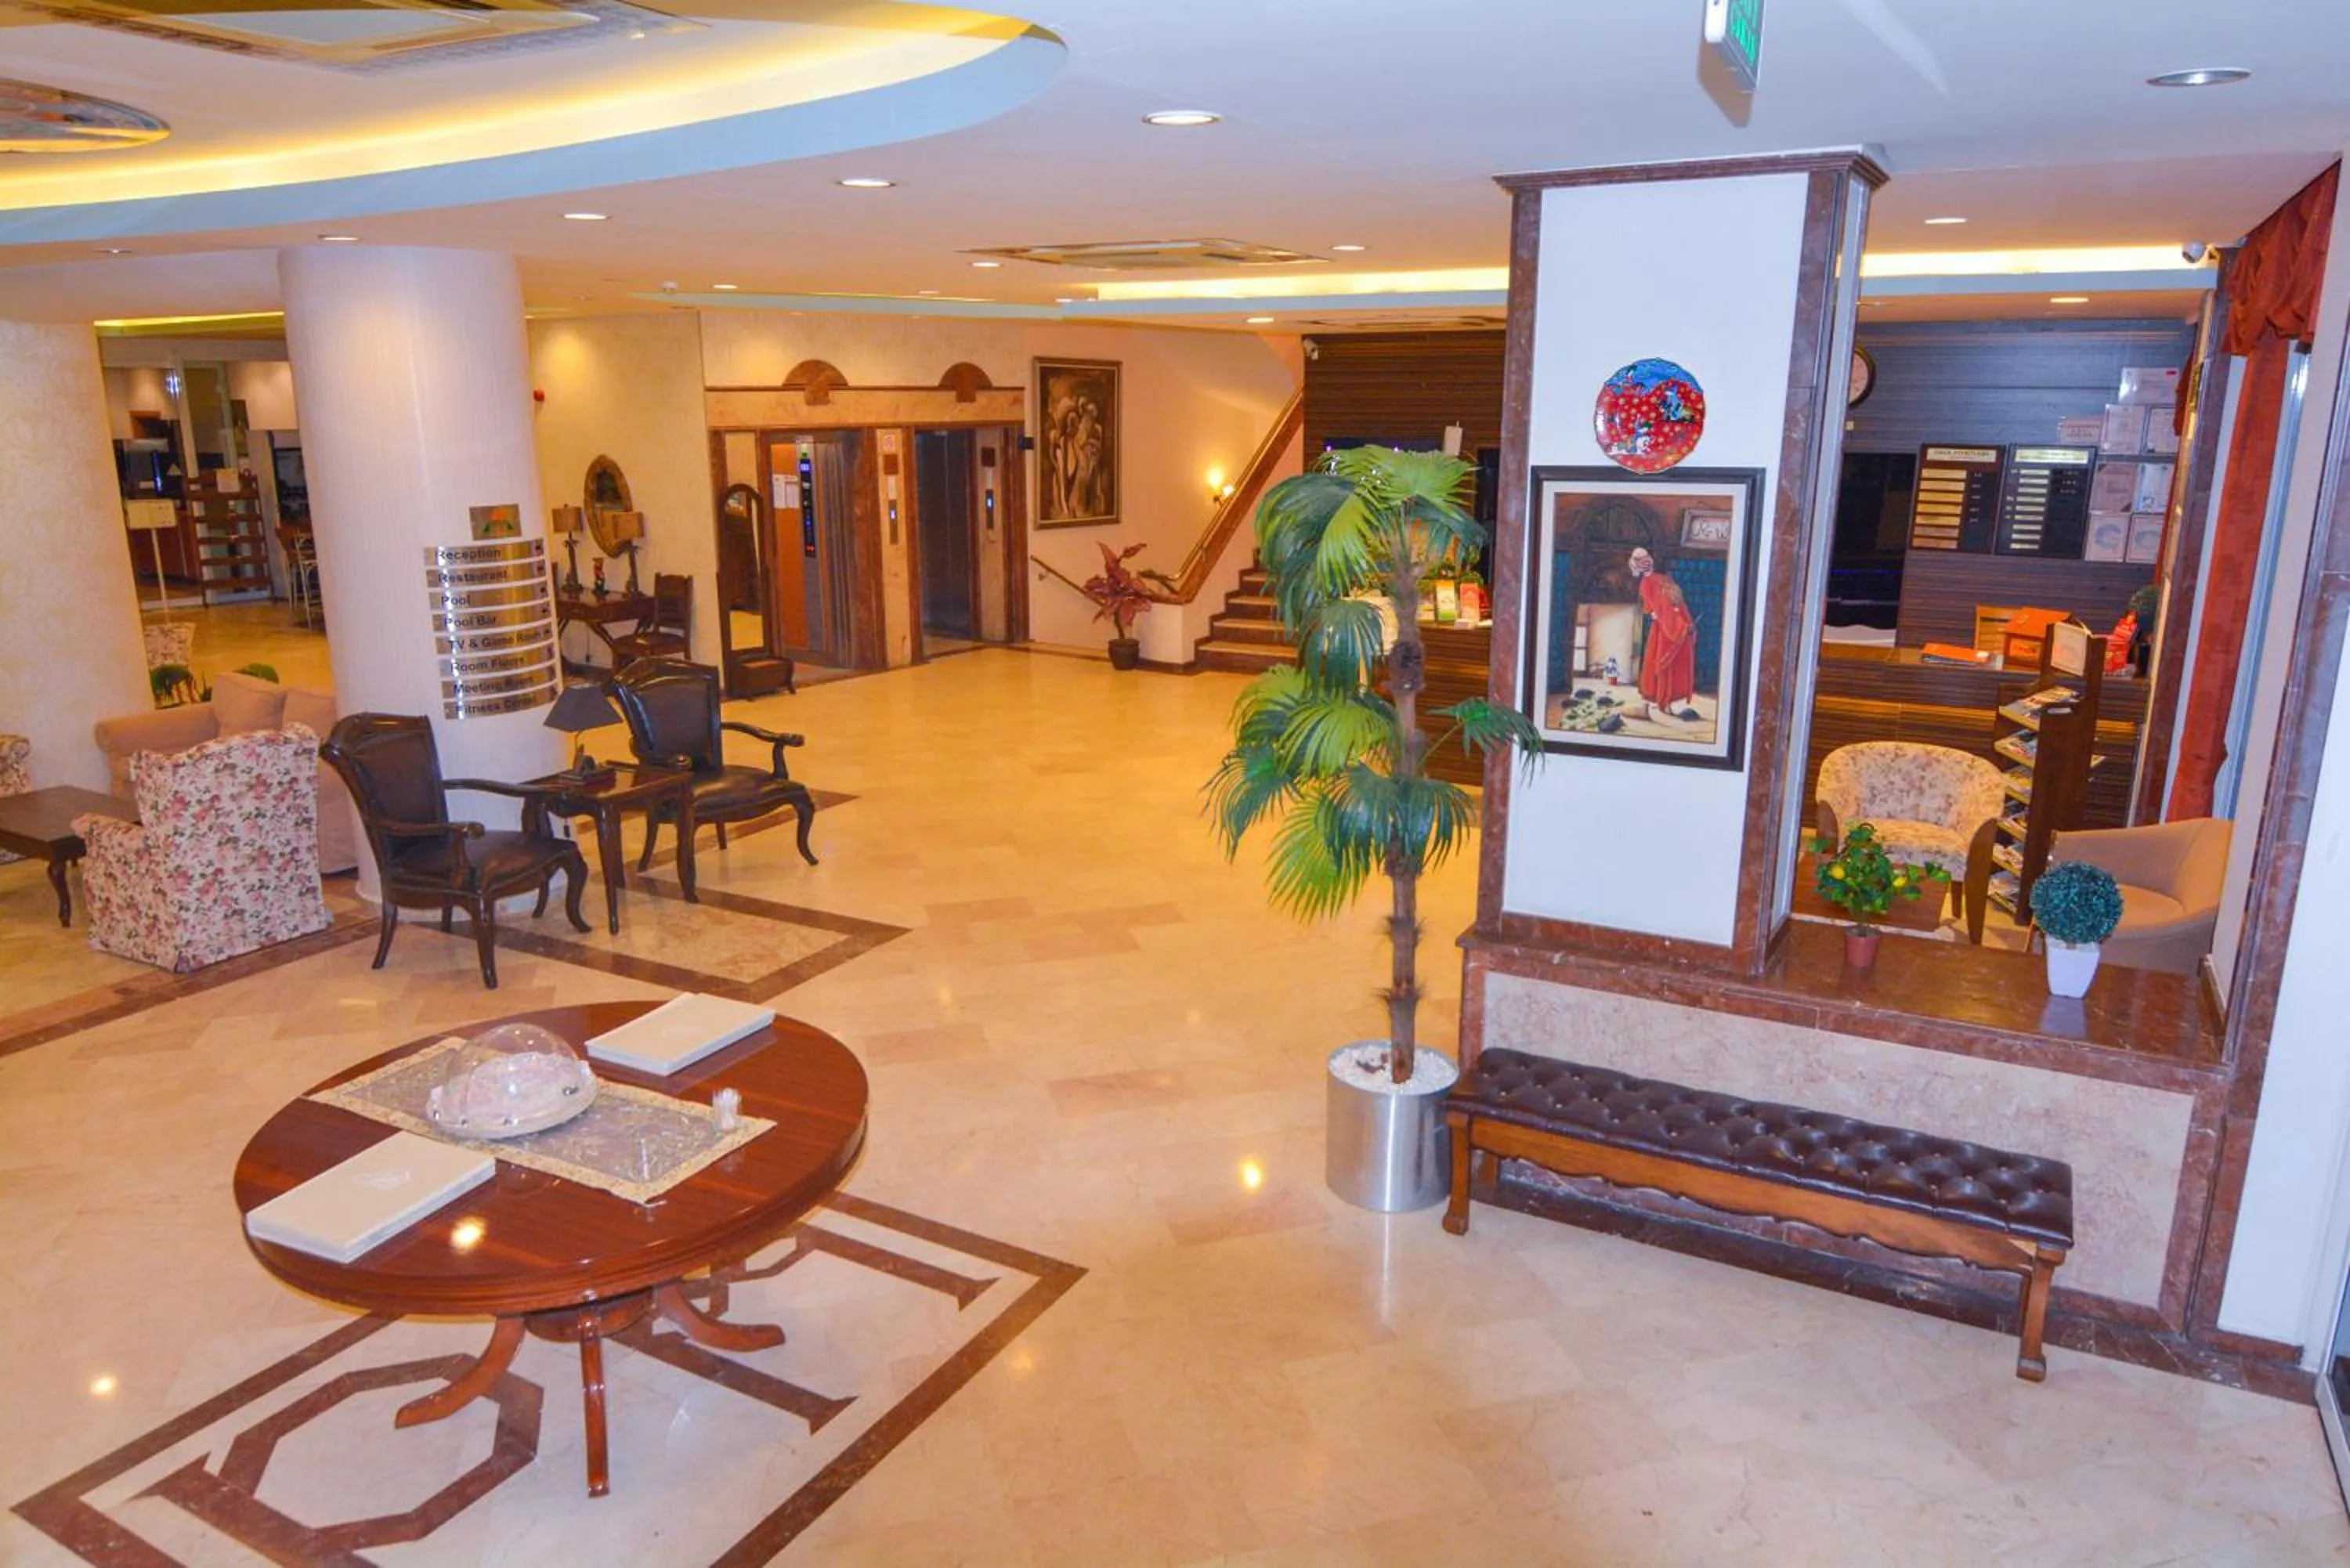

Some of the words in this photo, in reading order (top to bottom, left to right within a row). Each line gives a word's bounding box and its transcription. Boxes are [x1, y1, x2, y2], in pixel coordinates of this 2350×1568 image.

[436, 549, 501, 560] Reception
[439, 570, 507, 583] Restaurant
[441, 594, 471, 605] Pool
[444, 616, 473, 627] Pool
[476, 616, 497, 626] Bar
[447, 639, 465, 650] TV
[468, 638, 478, 649] &
[450, 661, 487, 672] Room
